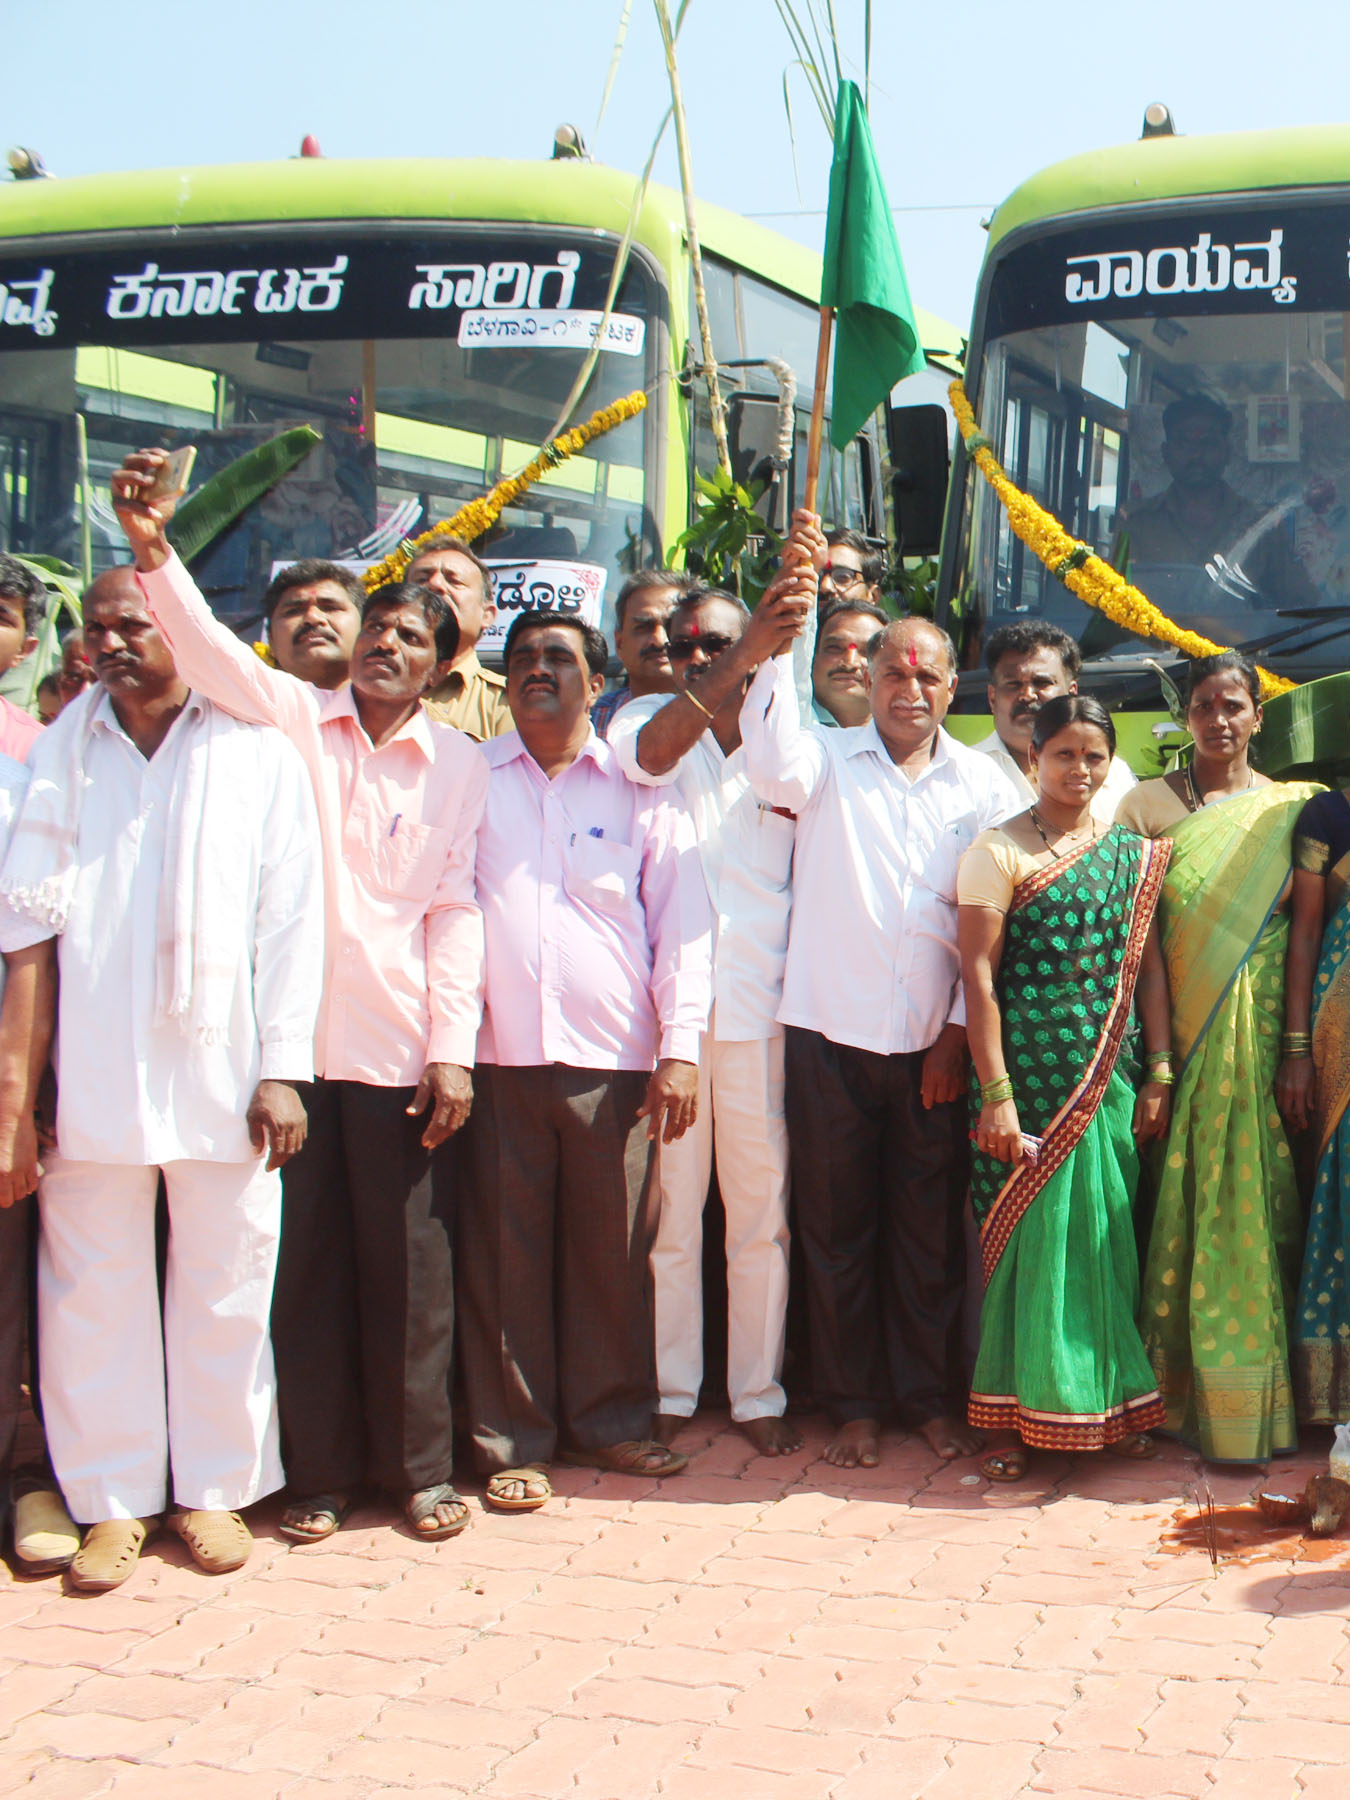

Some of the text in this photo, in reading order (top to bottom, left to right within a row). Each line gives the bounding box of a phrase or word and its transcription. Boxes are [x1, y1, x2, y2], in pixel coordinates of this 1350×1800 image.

[0, 250, 581, 336] ವ್ಯ ಕರ್ನಾಟಕ ಸಾರಿಗೆ
[1065, 229, 1297, 303] ವಾಯವ್ಯ
